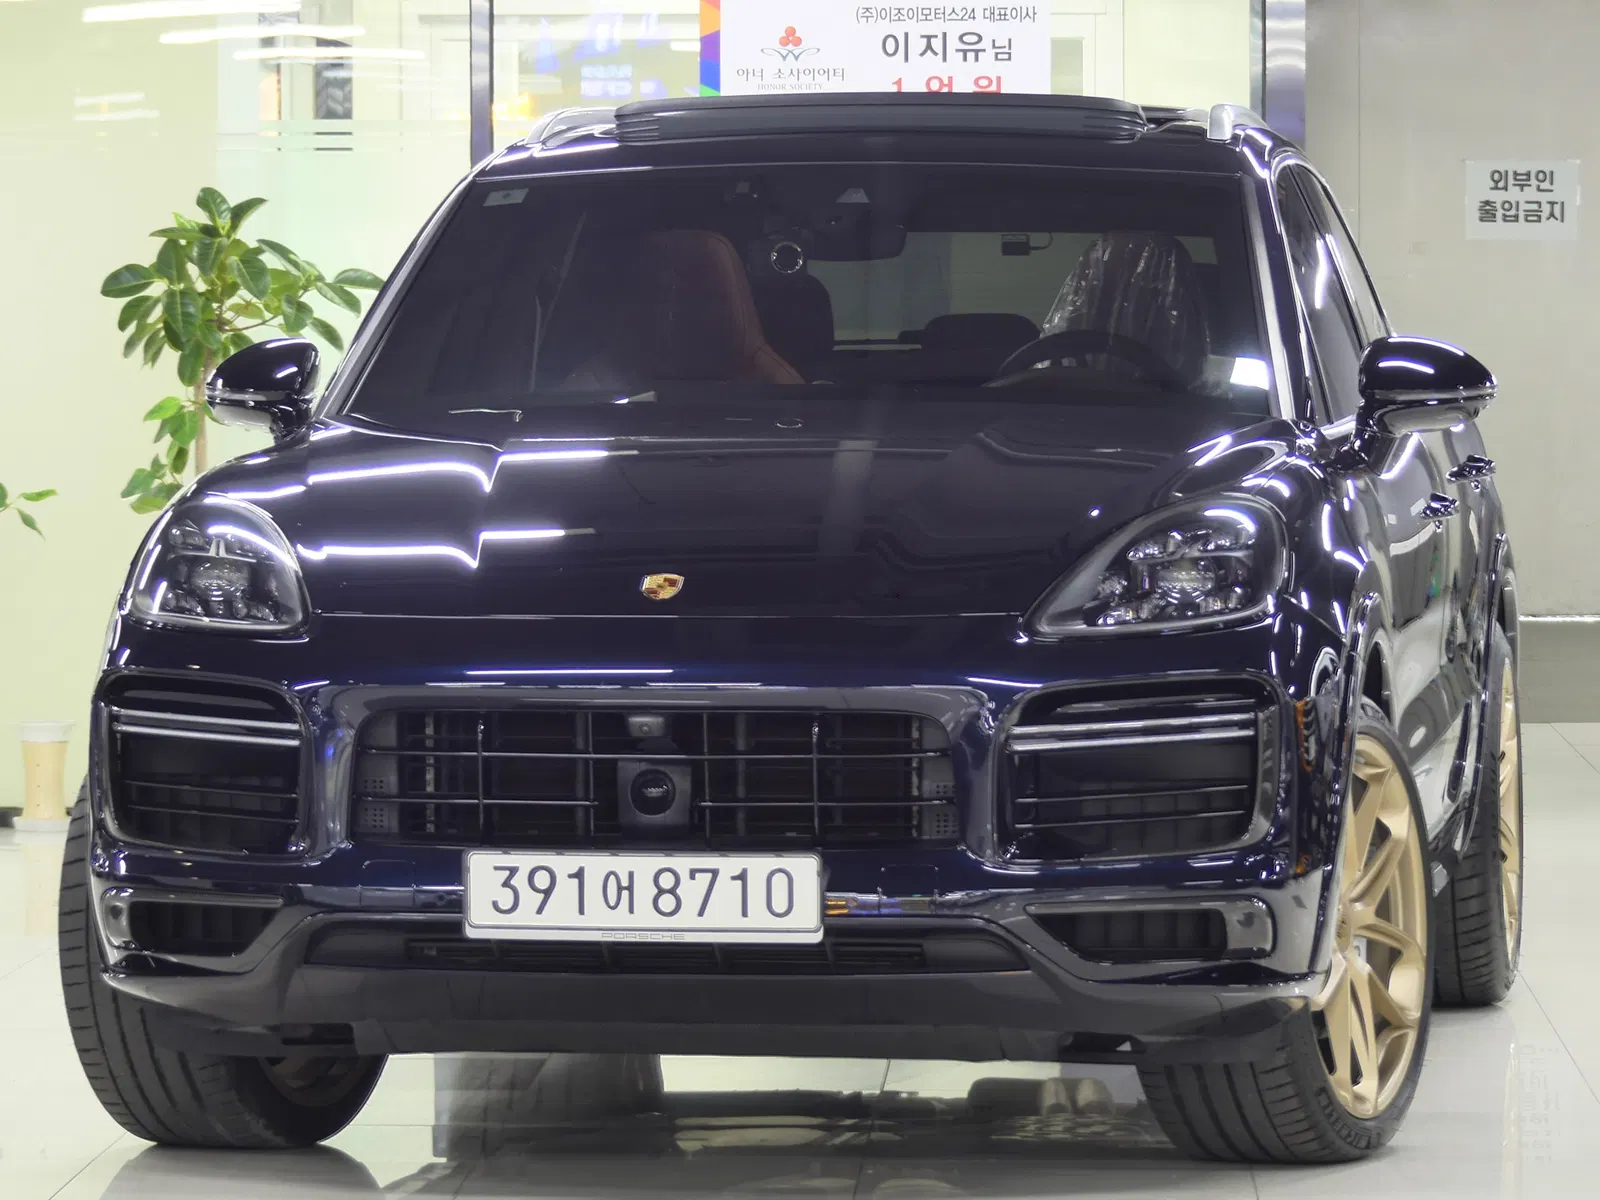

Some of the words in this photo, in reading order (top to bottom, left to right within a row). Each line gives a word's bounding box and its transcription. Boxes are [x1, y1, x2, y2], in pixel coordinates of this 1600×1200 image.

[856, 6, 976, 23] (주)이조이모터스24
[983, 6, 1037, 23] 대표이사
[881, 31, 1012, 63] 이지유님
[736, 68, 764, 82] 아너
[772, 67, 845, 82] 소사이어티
[757, 83, 787, 91] HONOR
[790, 83, 823, 91] SOCIETY
[1489, 169, 1554, 192] 외부인
[1478, 200, 1565, 223] 출입금지
[491, 865, 795, 918] 391어8710
[601, 932, 685, 940] PORSCHE
